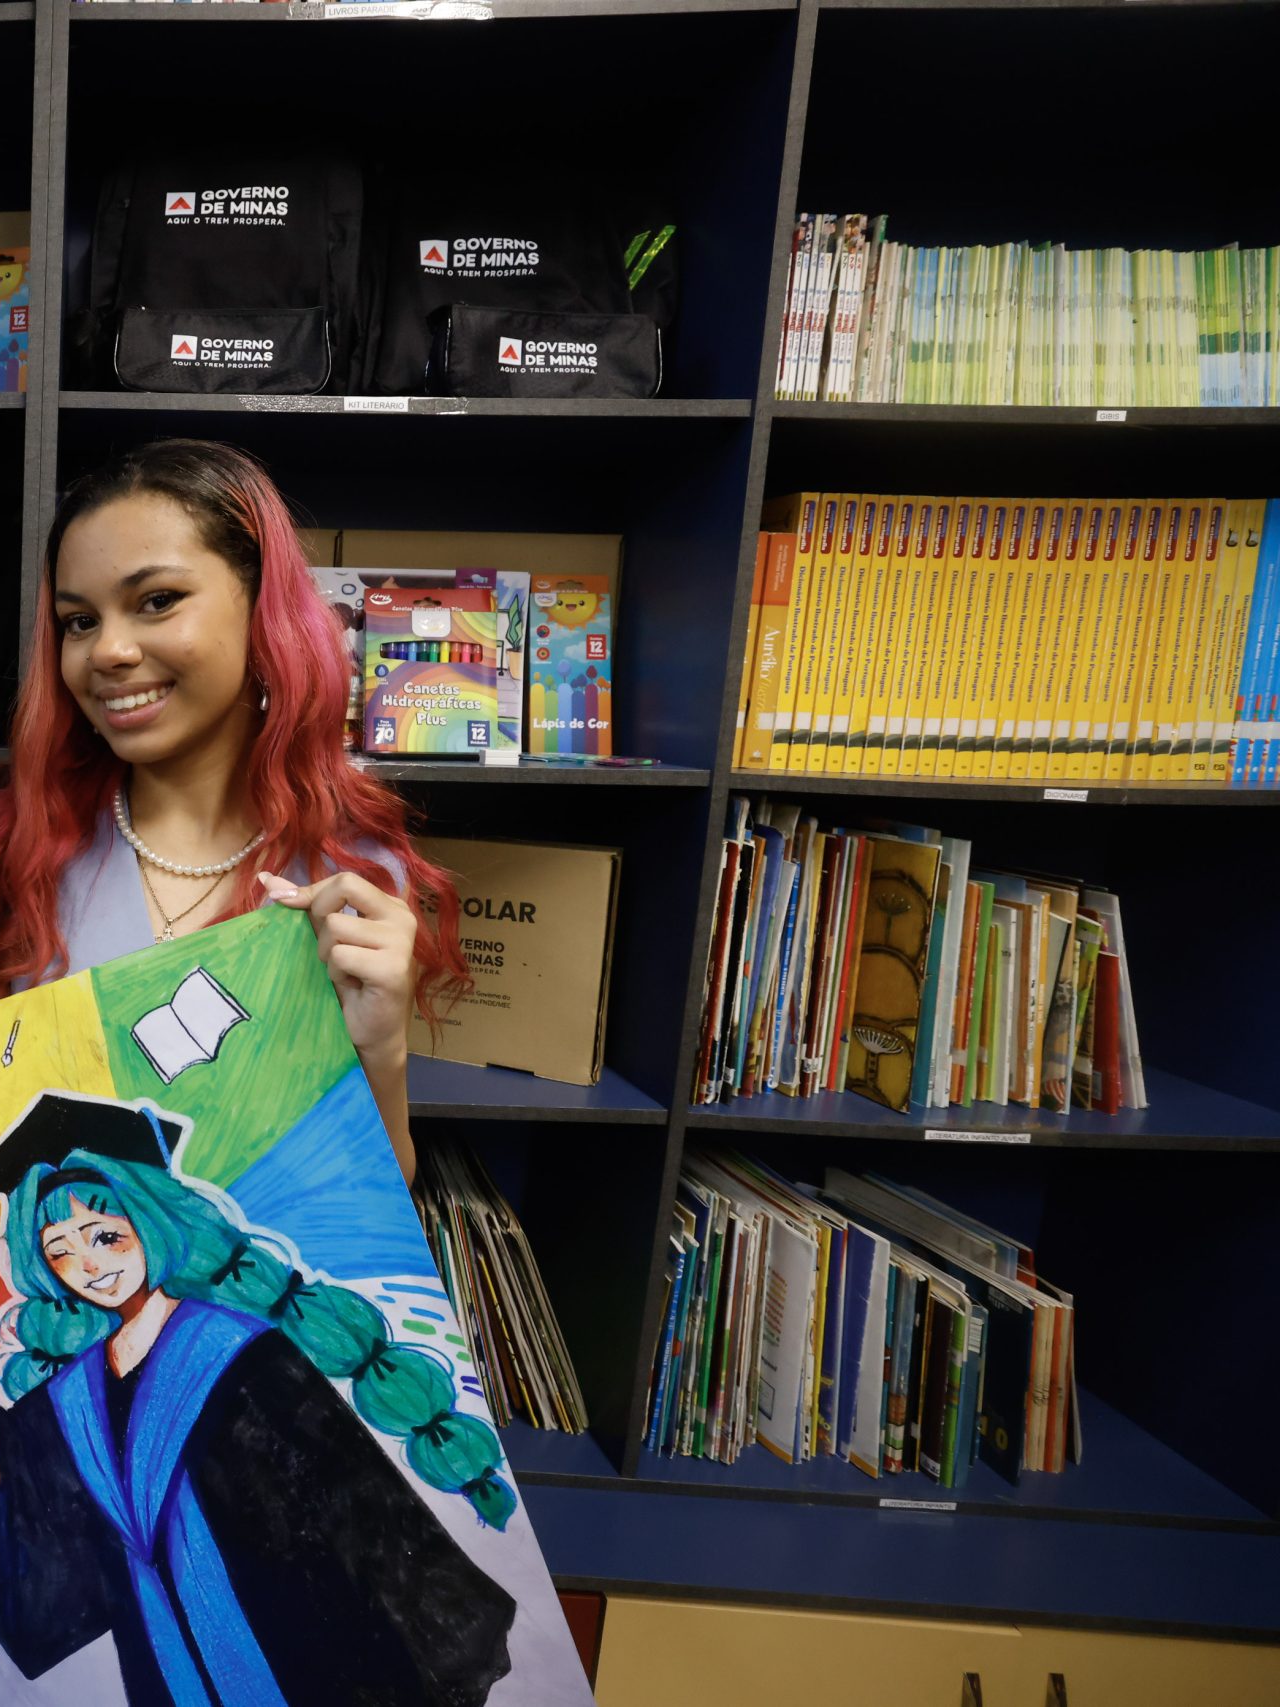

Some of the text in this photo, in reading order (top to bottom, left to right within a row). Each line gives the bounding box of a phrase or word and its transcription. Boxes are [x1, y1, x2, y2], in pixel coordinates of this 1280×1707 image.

[329, 8, 359, 16] LIVROS
[201, 186, 289, 201] GOVERNO
[201, 201, 288, 216] DE MINAS
[453, 238, 538, 250] GOVERNO
[453, 252, 539, 267] DE MINAS
[424, 267, 444, 275] AQUI
[14, 314, 25, 325] 12
[201, 338, 274, 350] GOVERNO
[525, 341, 597, 354] GOVERNO
[201, 350, 273, 362] DE MINAS
[525, 355, 597, 367] DE MINAS
[363, 400, 404, 409] LITERÁRIO
[590, 641, 603, 653] 12
[404, 681, 460, 695] Canetas
[382, 695, 481, 711] Hidrográficas
[416, 712, 448, 726] Plus
[533, 717, 608, 730] Lápis de Cor
[471, 727, 486, 740] 12
[463, 897, 536, 923] OLAR
[466, 953, 504, 967] INAS
